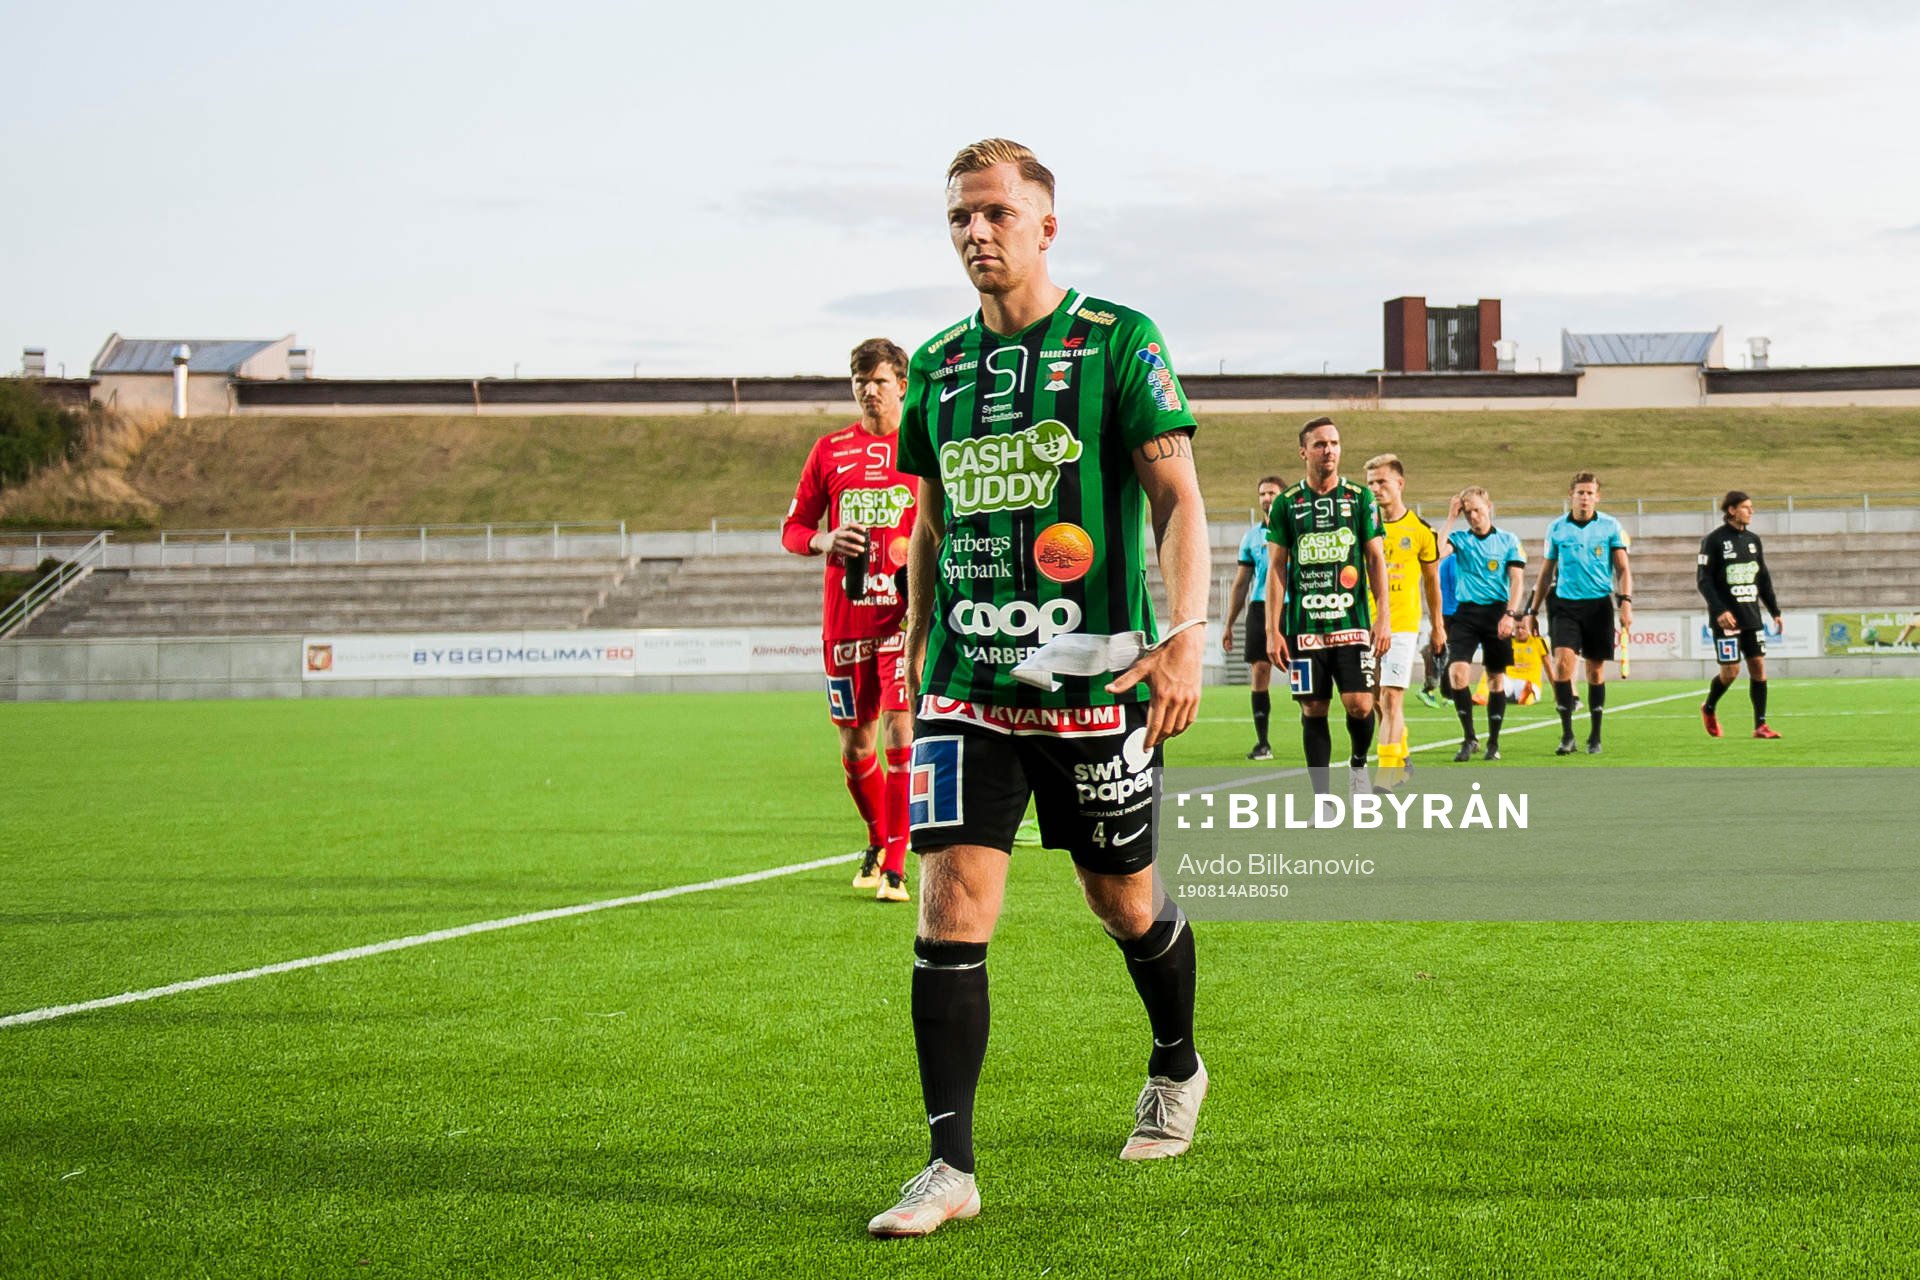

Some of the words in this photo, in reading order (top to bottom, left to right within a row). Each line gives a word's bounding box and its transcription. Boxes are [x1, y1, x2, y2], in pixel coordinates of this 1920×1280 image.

[982, 403, 1012, 415] System
[942, 440, 1025, 480] CASH
[841, 492, 888, 508] CASH
[944, 470, 1053, 507] BUDDY
[842, 508, 901, 525] BUDDY
[1301, 534, 1337, 548] CASH
[1301, 546, 1348, 562] BUDDY
[943, 558, 1013, 584] Sprbank
[1301, 592, 1354, 613] coop
[948, 598, 1083, 645] coop
[963, 645, 1040, 665] VARBE
[990, 704, 1115, 727] KVANTUM
[1074, 755, 1123, 782] swt
[1076, 767, 1153, 805] paper
[1092, 821, 1107, 849] 4
